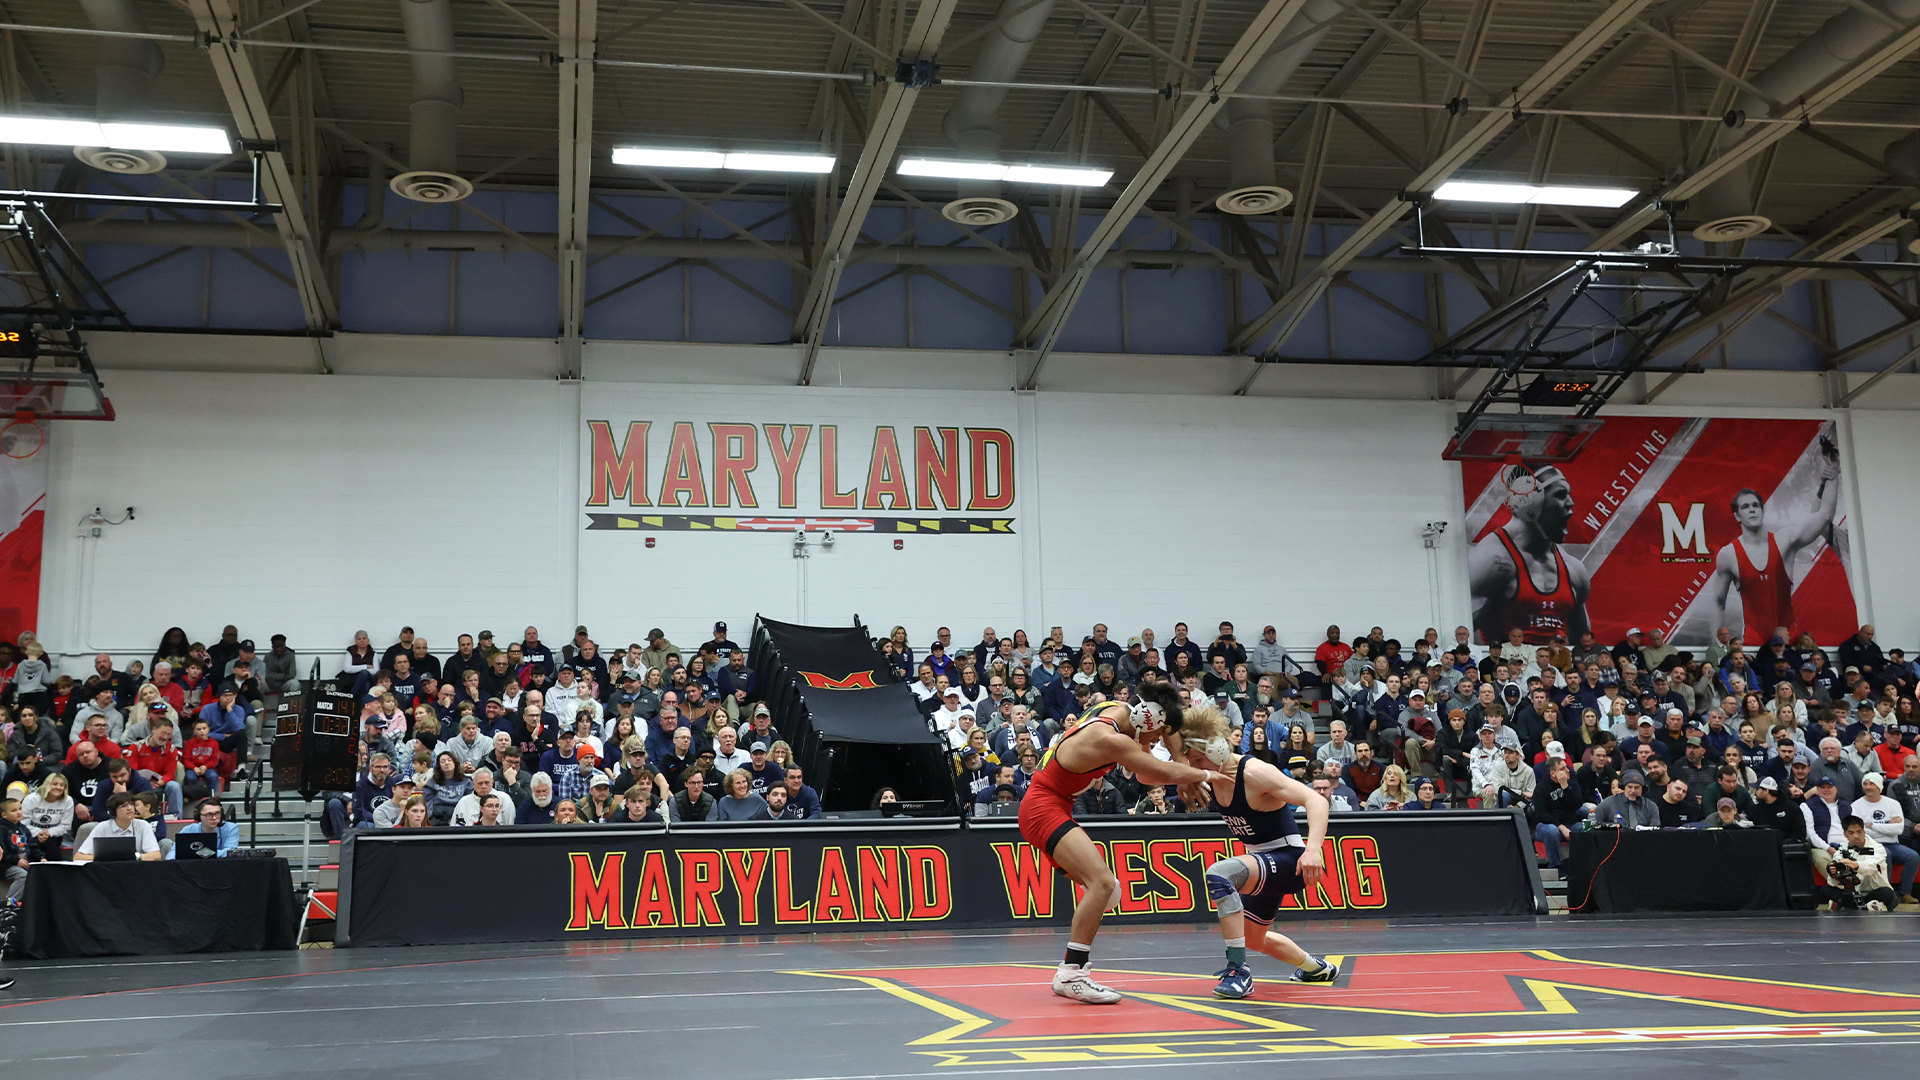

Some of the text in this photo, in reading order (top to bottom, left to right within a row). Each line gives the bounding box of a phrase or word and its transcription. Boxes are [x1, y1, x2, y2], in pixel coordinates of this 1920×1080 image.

[1553, 383, 1590, 392] 0:32
[585, 420, 1015, 511] MARYLAND
[1583, 429, 1667, 531] WRESTLING
[1657, 502, 1710, 555] M
[317, 701, 333, 710] MATCH
[323, 716, 348, 734] 0:32
[325, 767, 350, 784] 2:03
[1221, 815, 1247, 826] ENN
[1229, 826, 1255, 836] TATE
[565, 835, 1388, 931] MARYLAND WESTNG
